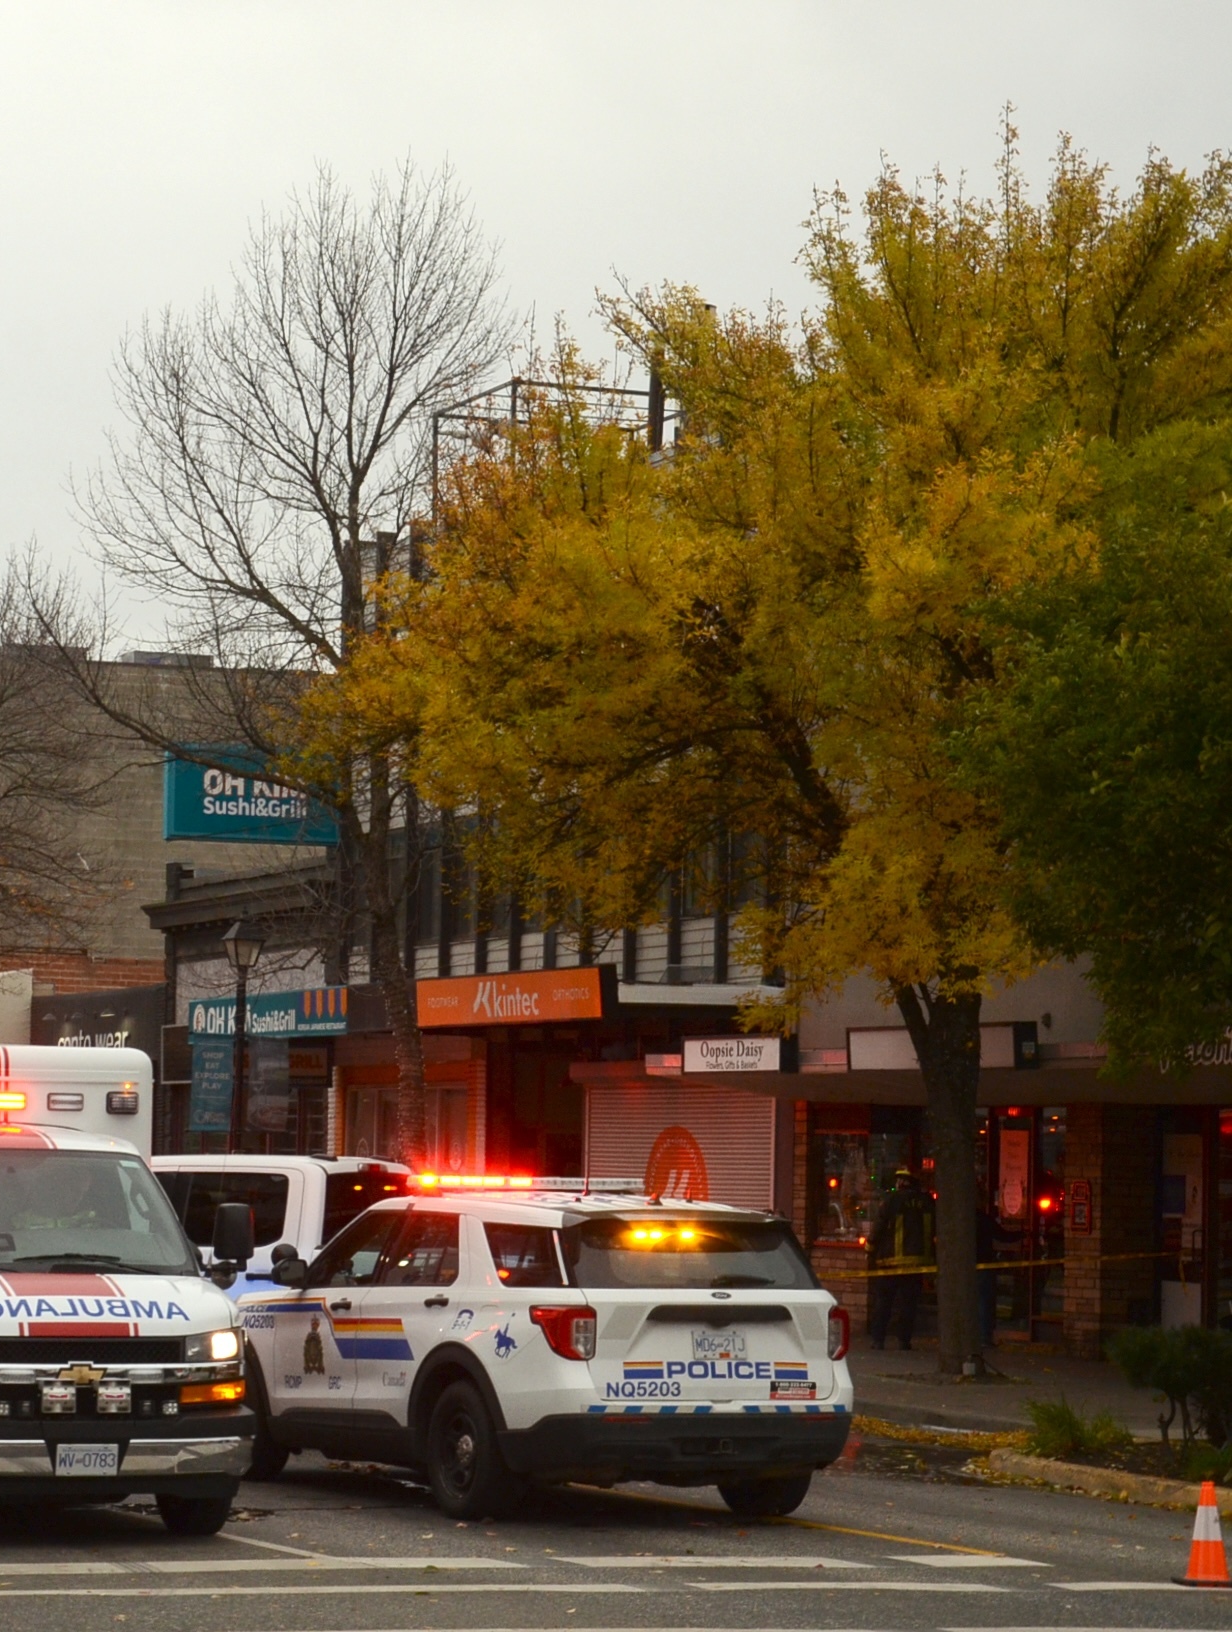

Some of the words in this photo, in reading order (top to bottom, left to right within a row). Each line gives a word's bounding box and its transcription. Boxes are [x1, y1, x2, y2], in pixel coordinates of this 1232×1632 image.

[203, 768, 245, 797] OH
[203, 796, 307, 819] Sushi&Grill
[552, 987, 590, 1001] ORTHOTICS
[206, 1005, 225, 1034] OH
[251, 1008, 296, 1034] Sushi&Grill
[95, 1031, 129, 1049] wear
[202, 1051, 225, 1060] SHOP
[700, 1041, 734, 1062] Oopsie
[736, 1040, 764, 1062] Daisy
[205, 1062, 220, 1070] EAT
[194, 1071, 231, 1081] EXPLORE
[201, 1081, 223, 1091] PLAY
[666, 1361, 773, 1379] POLICE
[284, 1375, 303, 1389] RCMP
[328, 1375, 342, 1390] GRC
[606, 1381, 682, 1398] NQ5203
